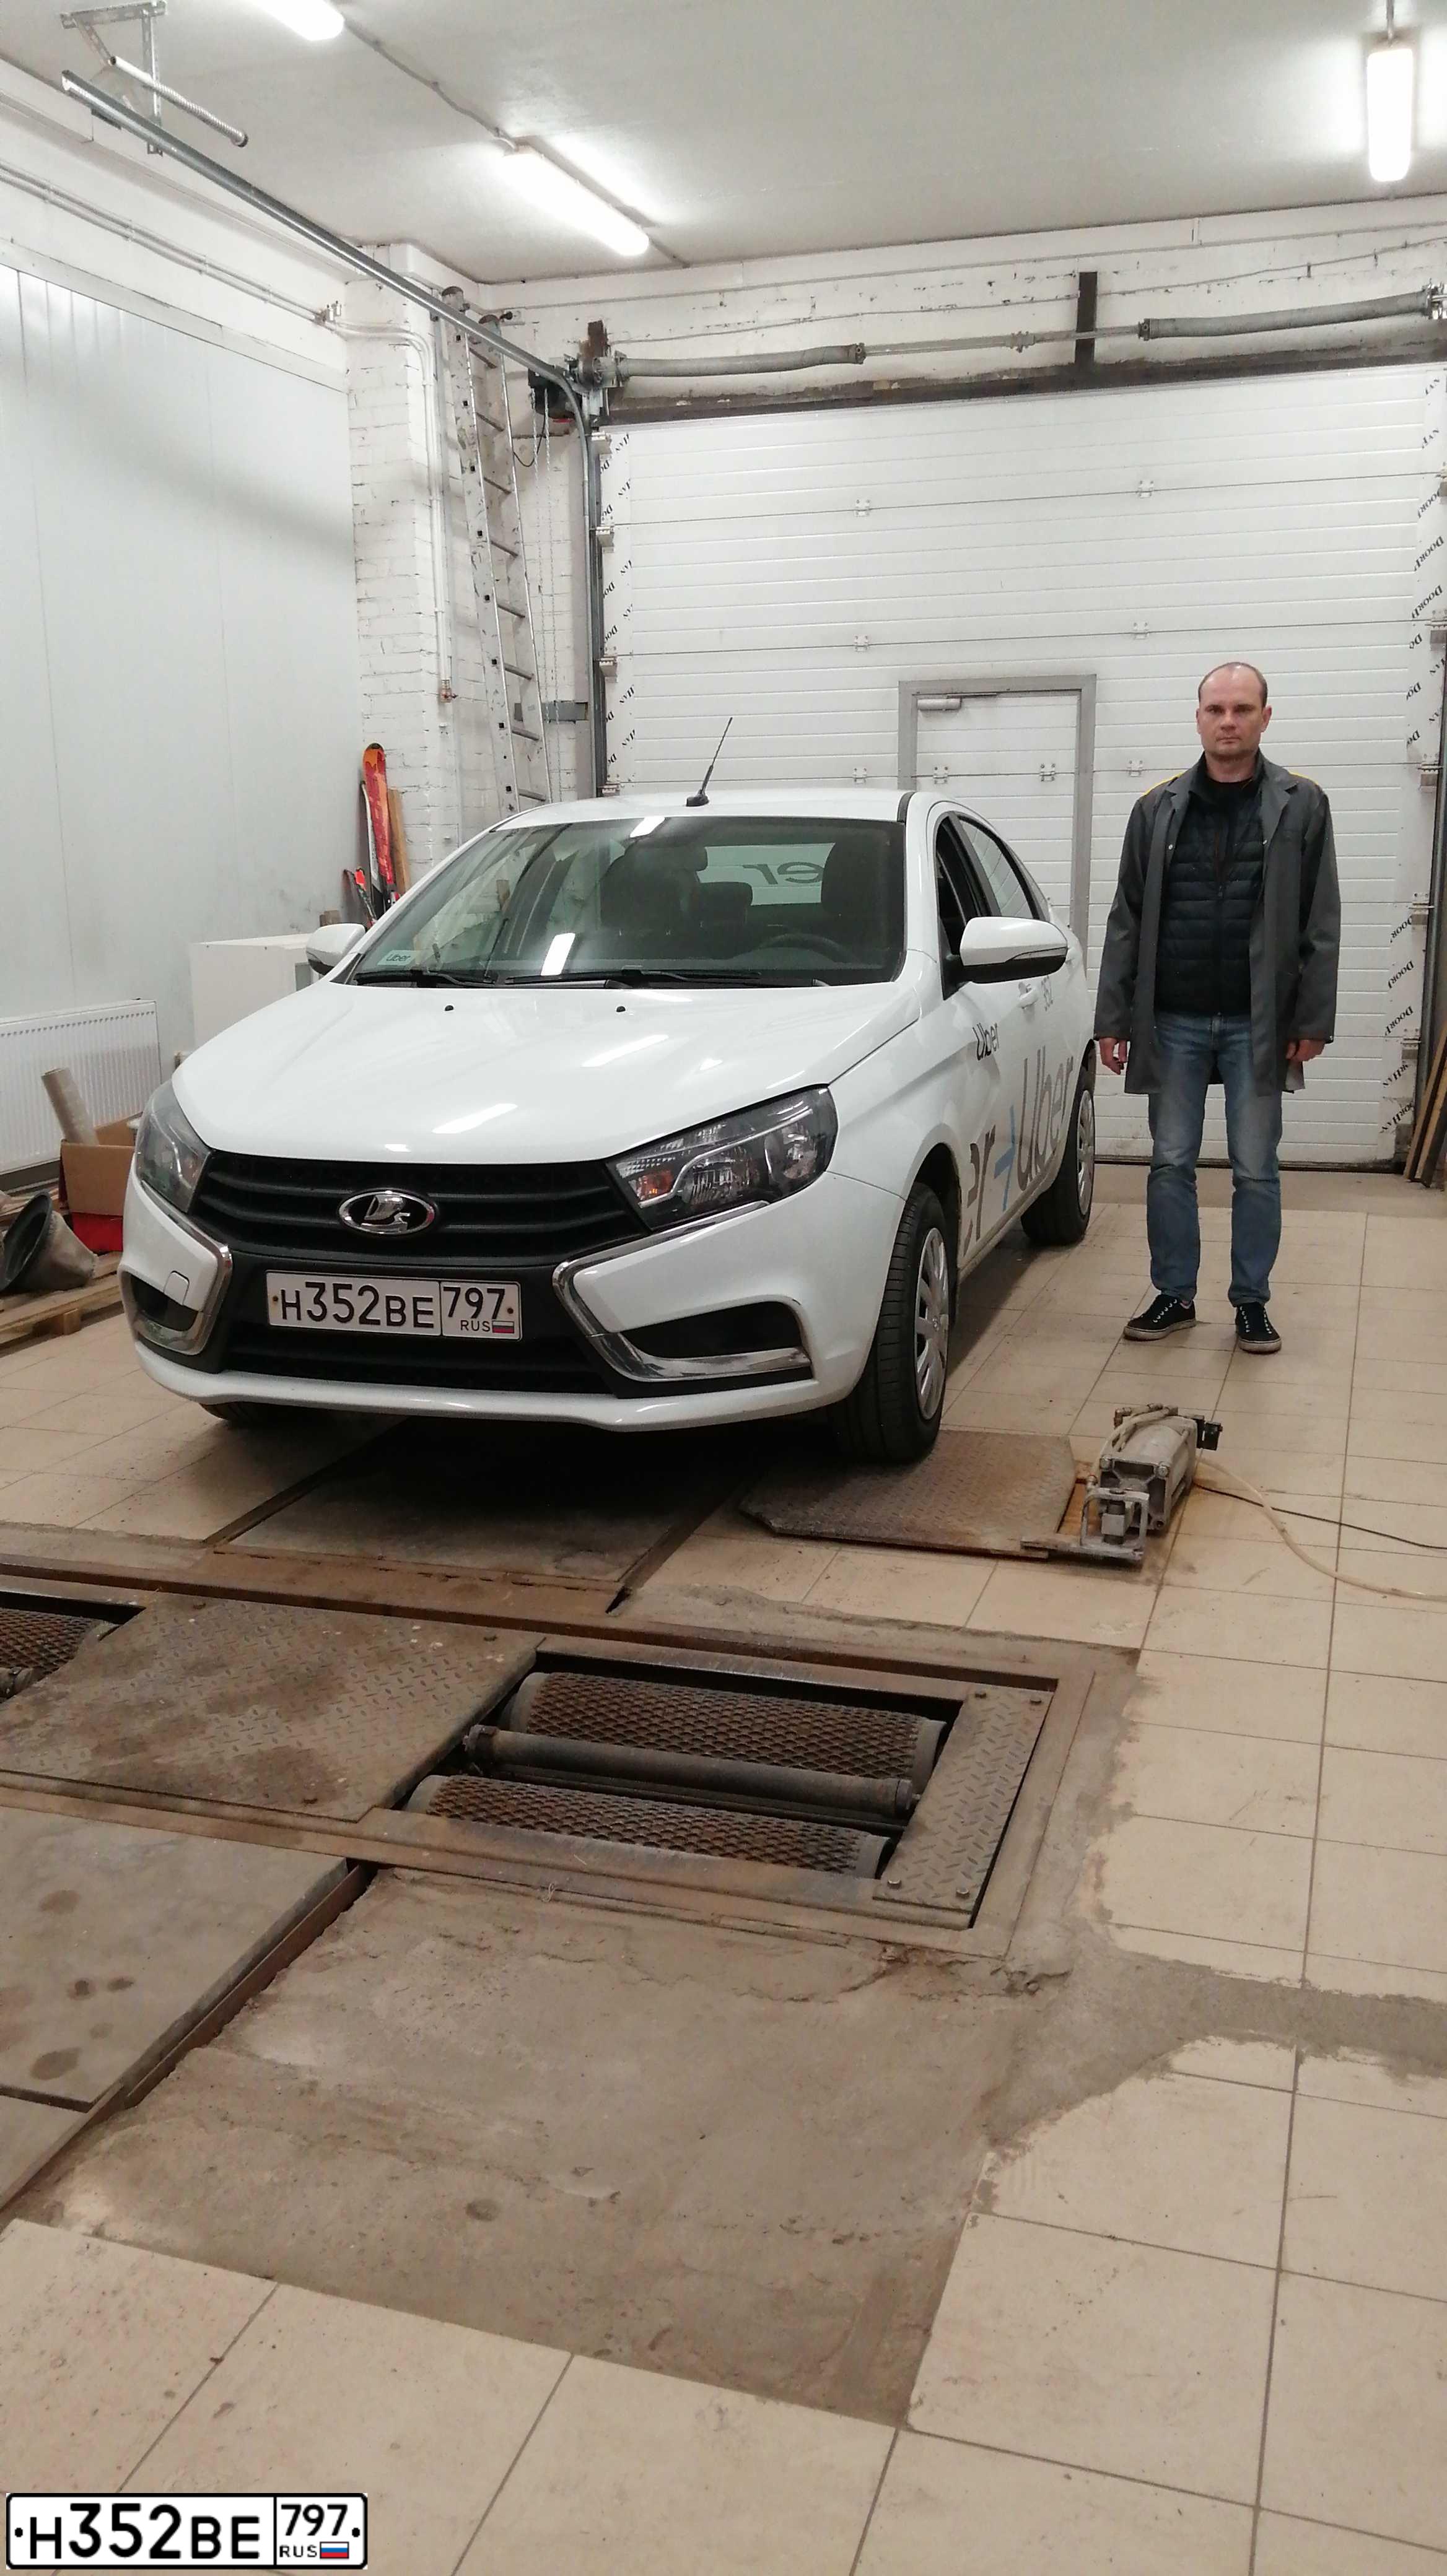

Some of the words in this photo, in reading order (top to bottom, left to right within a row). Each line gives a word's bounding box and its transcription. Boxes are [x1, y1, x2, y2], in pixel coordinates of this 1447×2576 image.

[973, 1022, 1000, 1061] Uber
[1017, 1045, 1073, 1192] Uber
[443, 1286, 506, 1320] 797
[460, 1320, 491, 1333] RUS
